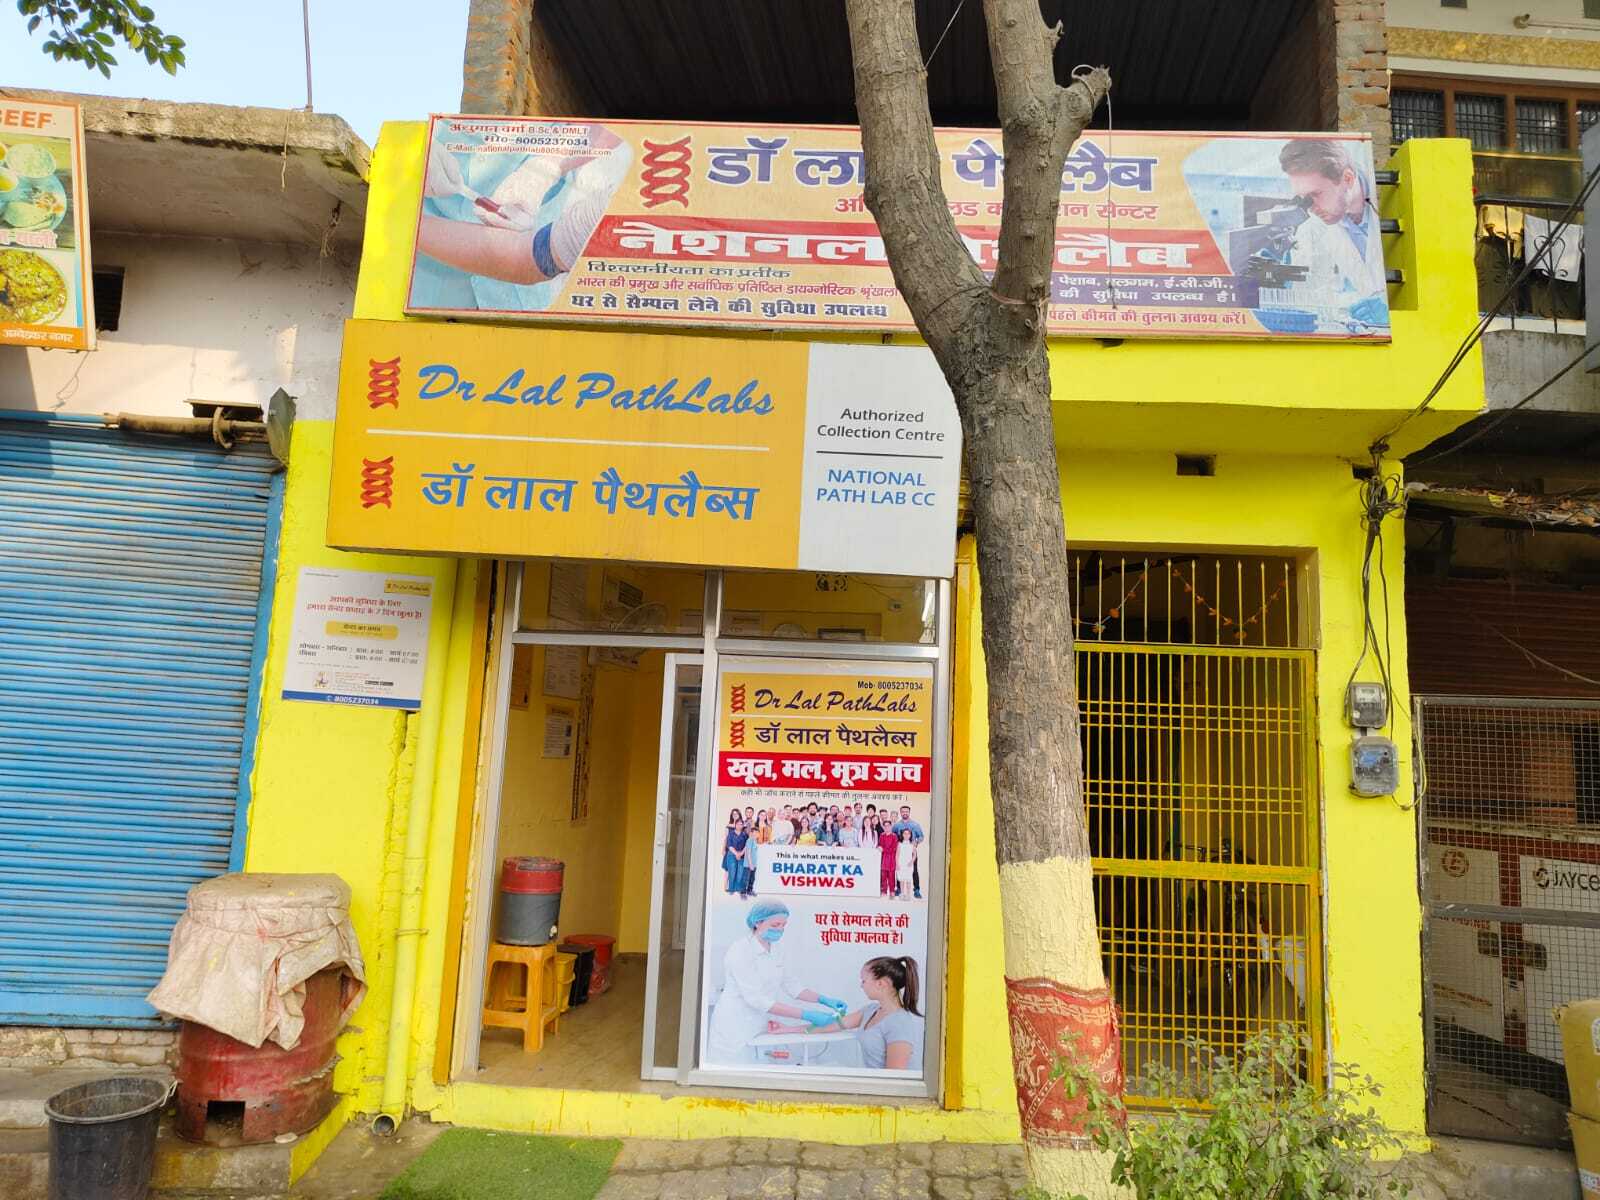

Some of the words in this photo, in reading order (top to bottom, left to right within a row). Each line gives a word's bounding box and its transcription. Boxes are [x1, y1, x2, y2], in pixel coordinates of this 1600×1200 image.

[0, 109, 52, 128] EEF
[562, 127, 589, 136] DMLT
[707, 137, 788, 186] डॉ
[794, 150, 865, 187] ला
[951, 138, 1158, 192] पैलैब
[1096, 200, 1159, 220] सेन्टर
[612, 221, 888, 261] नेशनल
[588, 261, 704, 275] विश्वसनीयता
[709, 265, 733, 277] का
[735, 266, 791, 279] प्रतीक
[577, 277, 606, 288] भारत
[609, 275, 625, 288] की
[629, 278, 659, 293] प्रमुख
[663, 276, 684, 290] और
[687, 279, 734, 292] सर्वाधिक
[738, 279, 783, 294] प्रतिष्ठित
[571, 294, 594, 308] घर
[602, 293, 617, 308] से
[626, 294, 679, 310] सैम्पल
[688, 296, 719, 312] लेने
[728, 298, 751, 313] की
[761, 299, 816, 317] सुविधा
[824, 303, 888, 317] उपलब्ध
[1059, 287, 1079, 299] की
[1092, 288, 1138, 304] सुविधा
[1151, 291, 1204, 302] उपलब्ध
[1082, 308, 1117, 321] कीमत
[1121, 309, 1137, 322] की
[1142, 311, 1177, 326] तुलना
[1180, 312, 1217, 324] अवश्य
[418, 363, 477, 401] Dr
[482, 368, 567, 406] Lal
[575, 371, 775, 416] PathLabs
[840, 408, 925, 423] Authorized
[817, 424, 891, 439] Collection
[895, 428, 945, 442] Centre
[828, 468, 927, 487] NATIONAL
[421, 463, 476, 508] डॉ
[484, 475, 578, 512] लाल
[592, 467, 761, 521] पैथलैब्स
[816, 487, 866, 504] PATH
[871, 489, 906, 505] LAB
[911, 492, 936, 506] CC
[877, 681, 924, 690] 8005237034
[754, 688, 782, 709] Dr
[784, 689, 821, 710] Lal
[826, 690, 918, 713] PathLabs
[754, 722, 782, 744] डॉ
[784, 727, 832, 745] लाल
[836, 723, 918, 748] पैथलैब्स
[726, 757, 778, 784] खून,
[781, 759, 827, 783] मल,
[830, 760, 871, 787] मूत्र
[873, 757, 924, 783] जांच
[776, 852, 791, 860] This
[793, 852, 799, 860] is
[801, 852, 818, 860] what
[820, 853, 845, 861] makes
[772, 862, 838, 875] BHARAT
[842, 863, 864, 876] KA
[780, 875, 855, 889] VISHWAS
[815, 912, 828, 926] घर
[831, 911, 839, 926] से
[874, 912, 892, 928] लेने
[895, 913, 910, 929] की
[821, 927, 852, 946] सुविधा
[855, 931, 889, 944] उपलब्ध
